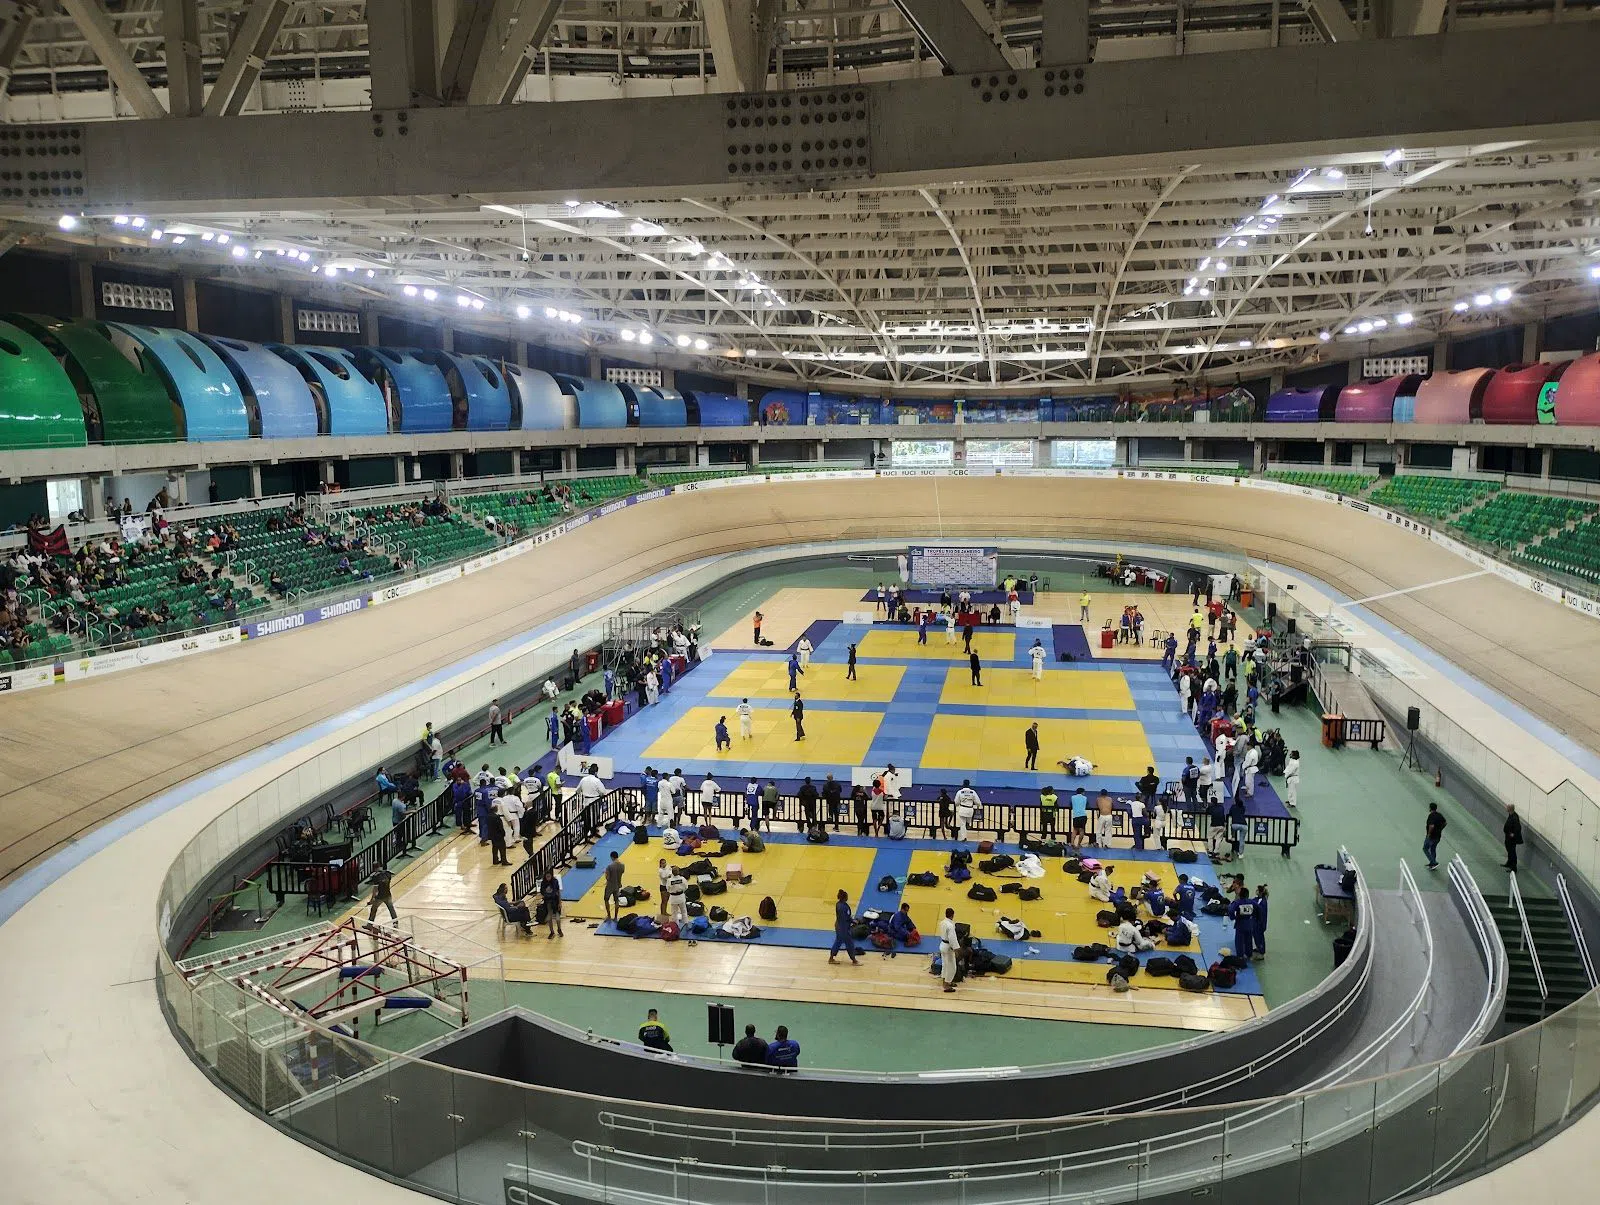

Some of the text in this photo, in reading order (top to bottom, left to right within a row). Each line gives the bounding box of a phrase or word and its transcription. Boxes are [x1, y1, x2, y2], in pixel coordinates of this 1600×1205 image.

[687, 482, 699, 491] CBC
[637, 488, 665, 503] SHIMANO
[600, 499, 627, 516] SHIMANO
[387, 587, 400, 599] CBC
[320, 598, 361, 620] SHIMANO
[257, 613, 305, 636] SHIMANO
